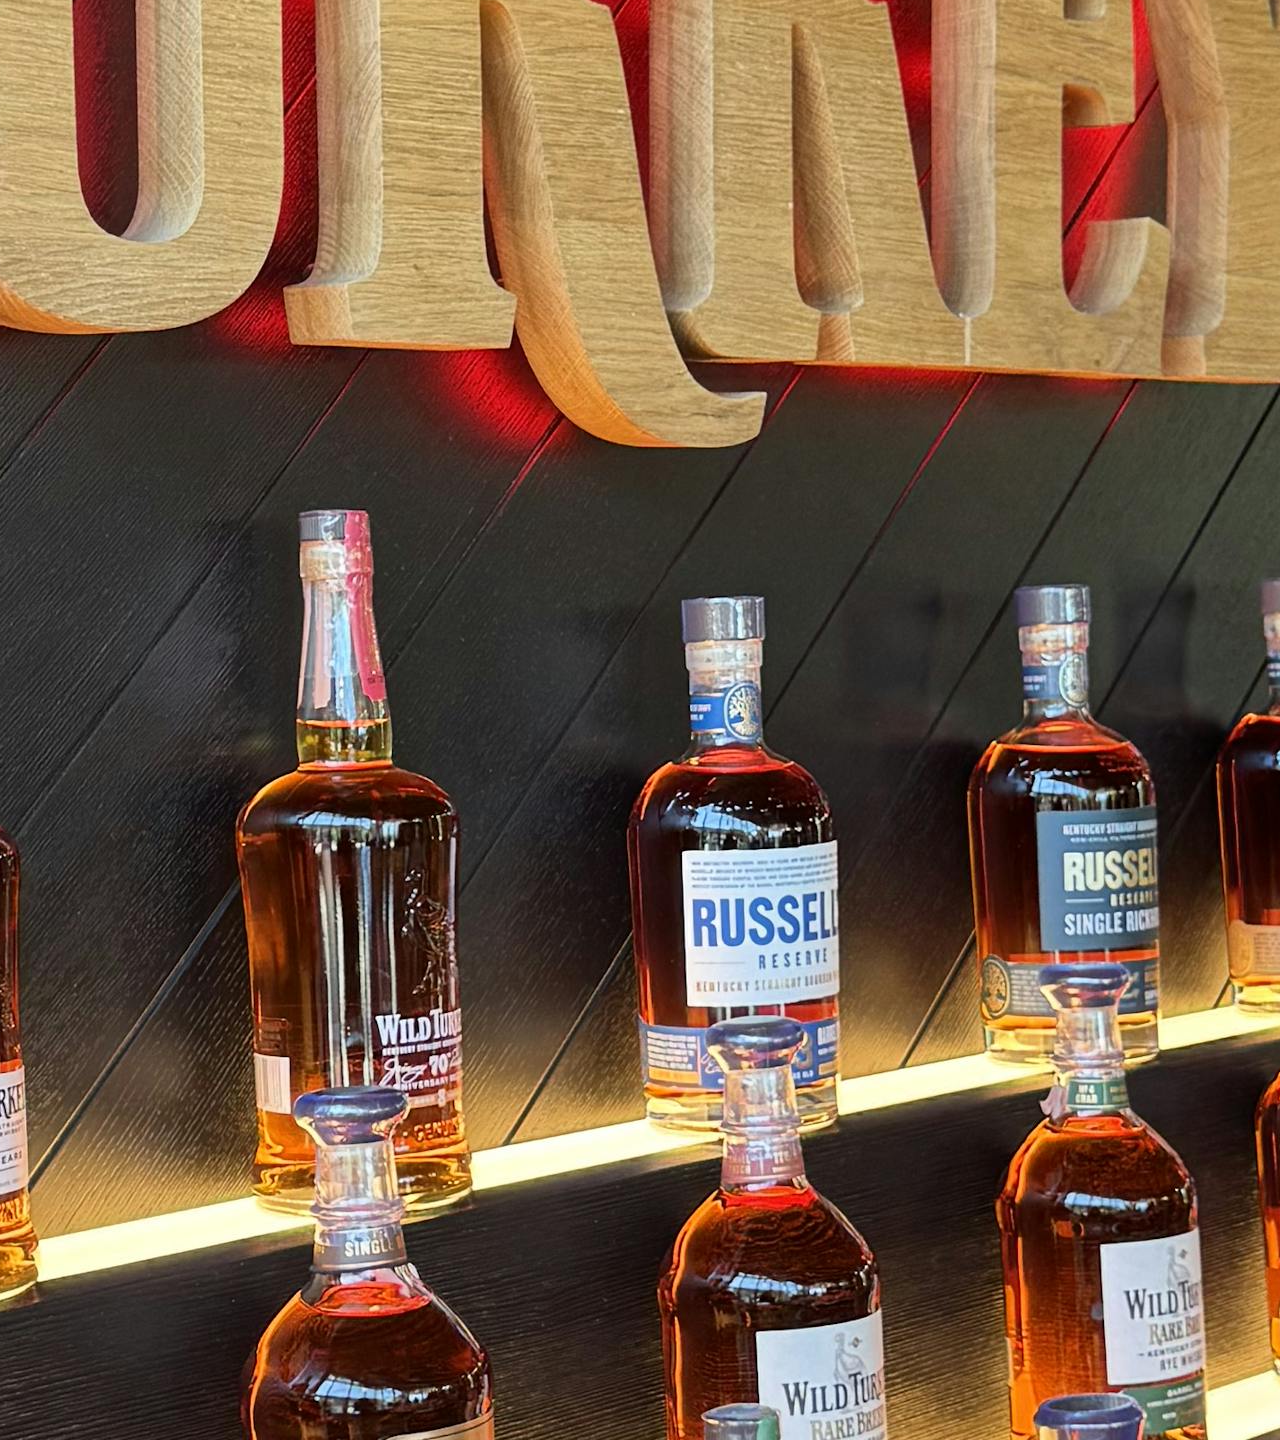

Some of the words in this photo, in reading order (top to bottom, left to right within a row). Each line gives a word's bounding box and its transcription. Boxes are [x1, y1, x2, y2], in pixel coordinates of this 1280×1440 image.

[1063, 823, 1106, 835] KENTUCKY
[1064, 911, 1122, 936] SINGLE
[758, 948, 828, 970] RESERVE
[696, 980, 749, 993] KENTUCKY
[755, 975, 801, 991] STRAIGHT
[375, 1014, 432, 1046] WILD
[1124, 1288, 1179, 1320] WILD
[1148, 1319, 1184, 1346] RARE
[1160, 1359, 1178, 1371] RYE
[783, 1381, 848, 1416] WILD
[810, 1416, 855, 1440] RARE
